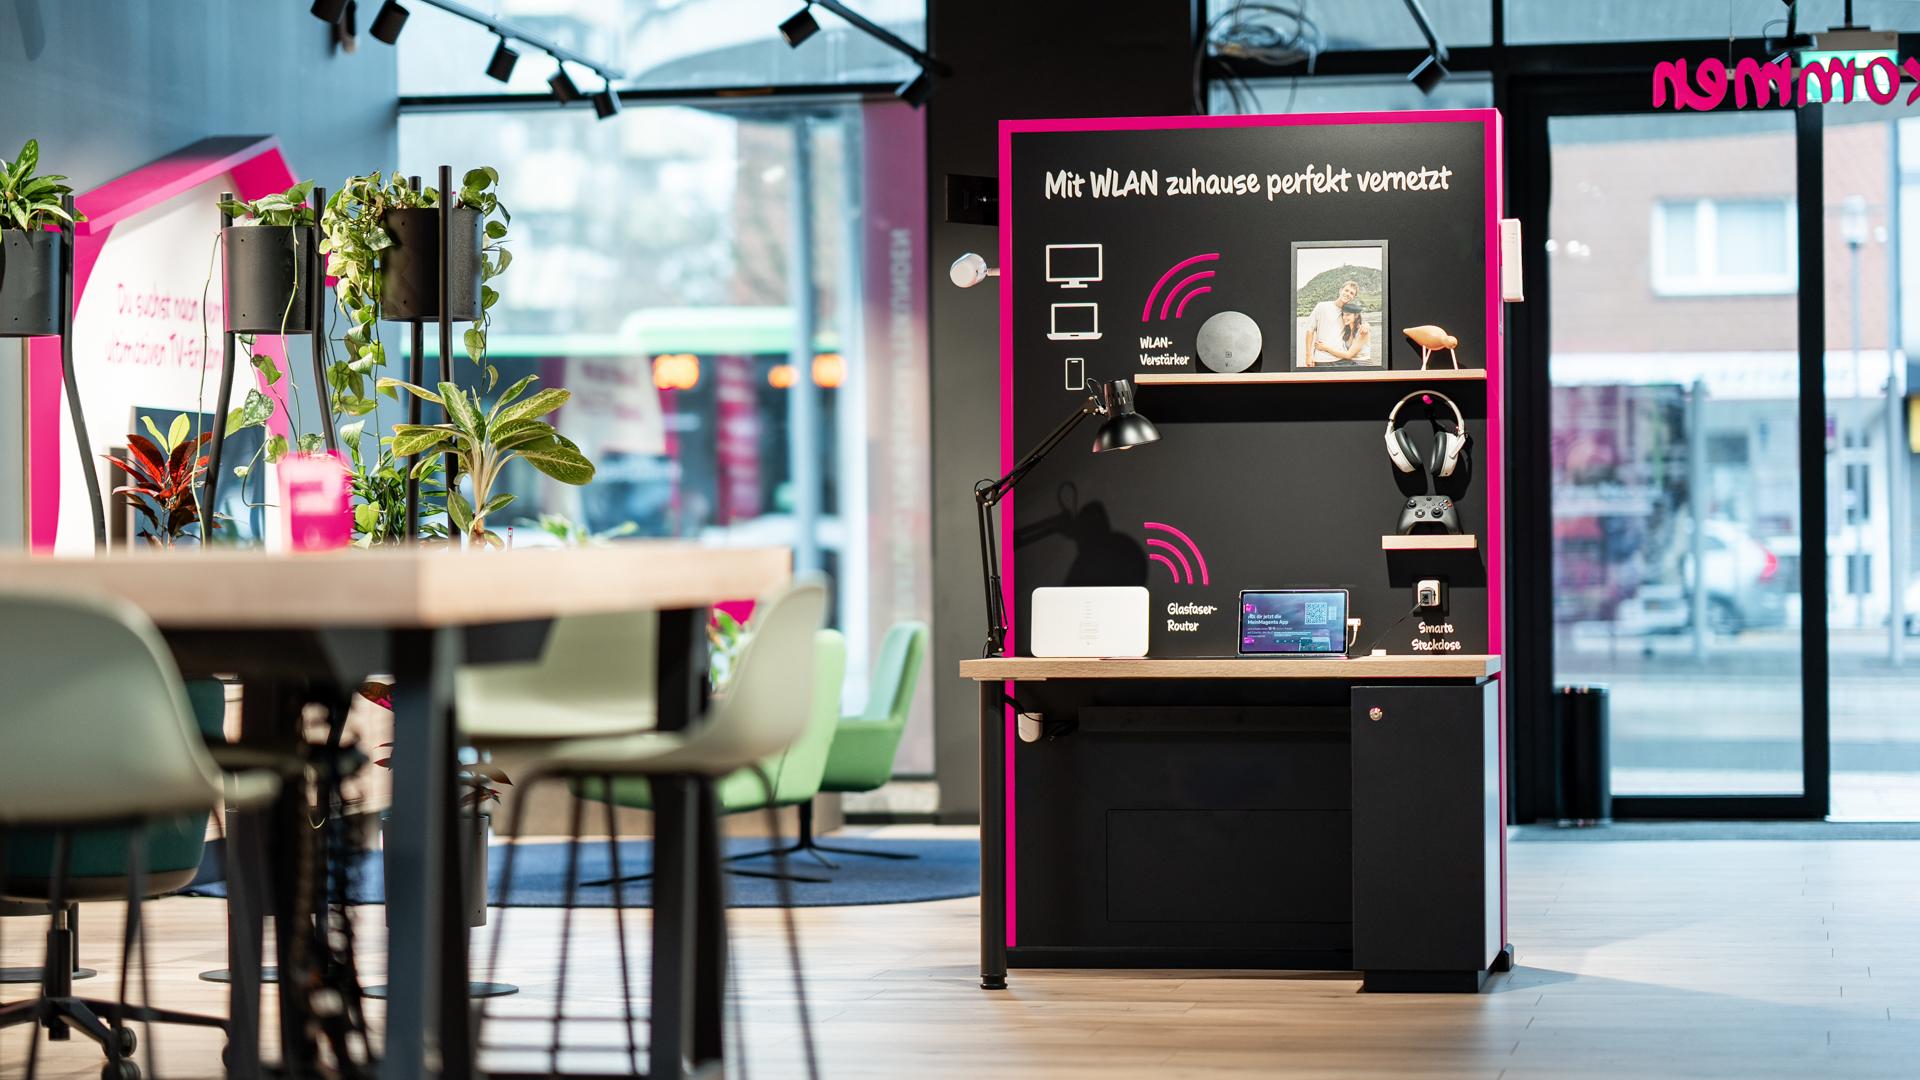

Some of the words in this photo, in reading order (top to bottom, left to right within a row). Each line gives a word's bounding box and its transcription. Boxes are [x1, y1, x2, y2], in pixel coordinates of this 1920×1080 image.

[1045, 169, 1084, 200] Mit
[1089, 167, 1158, 199] WLAN
[1165, 167, 1261, 197] zuhause
[1266, 163, 1353, 202] perfekt
[1356, 165, 1453, 194] vernetzt
[1139, 335, 1173, 350] WLAN-
[1139, 352, 1190, 366] Verstärker
[1167, 601, 1218, 616] Glasfaser-
[1167, 618, 1200, 632] Router
[1418, 621, 1454, 634] Smarte
[1411, 638, 1462, 651] Steckdose
